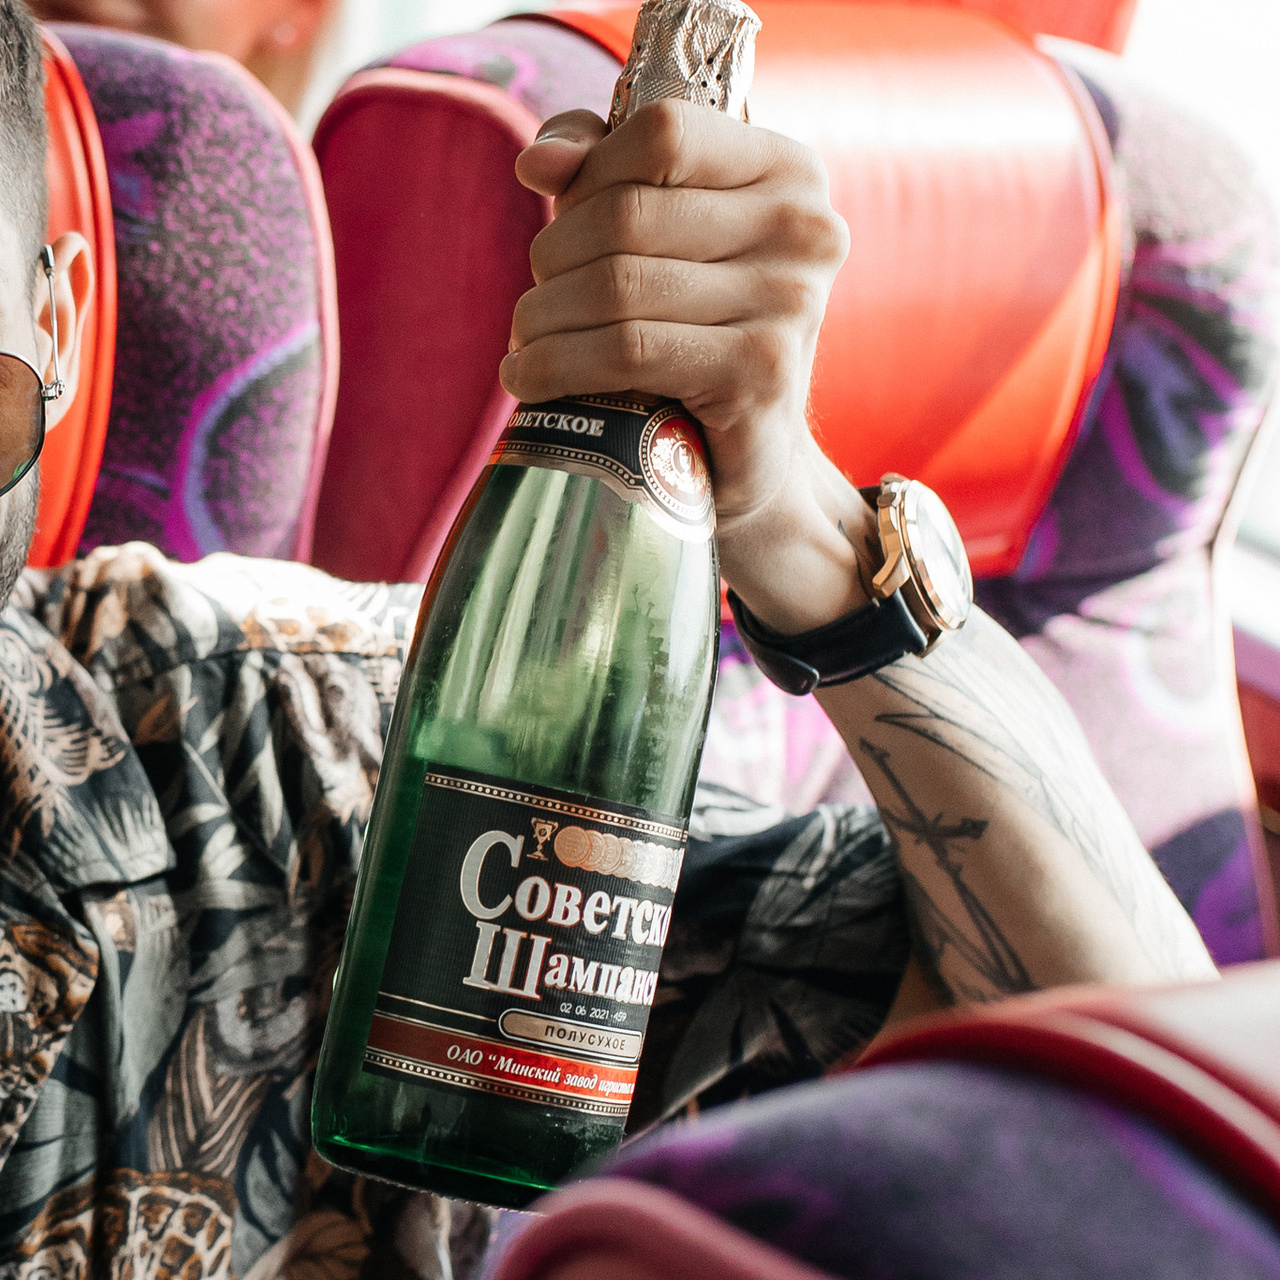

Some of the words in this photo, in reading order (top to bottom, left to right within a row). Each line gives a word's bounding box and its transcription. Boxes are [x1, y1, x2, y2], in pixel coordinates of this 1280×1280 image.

[560, 1002, 572, 1013] 02
[575, 1005, 587, 1016] 06
[544, 1025, 626, 1050] ПОЛУСУХОЕ
[446, 1044, 483, 1066] ОАО
[563, 1073, 598, 1090] завод
